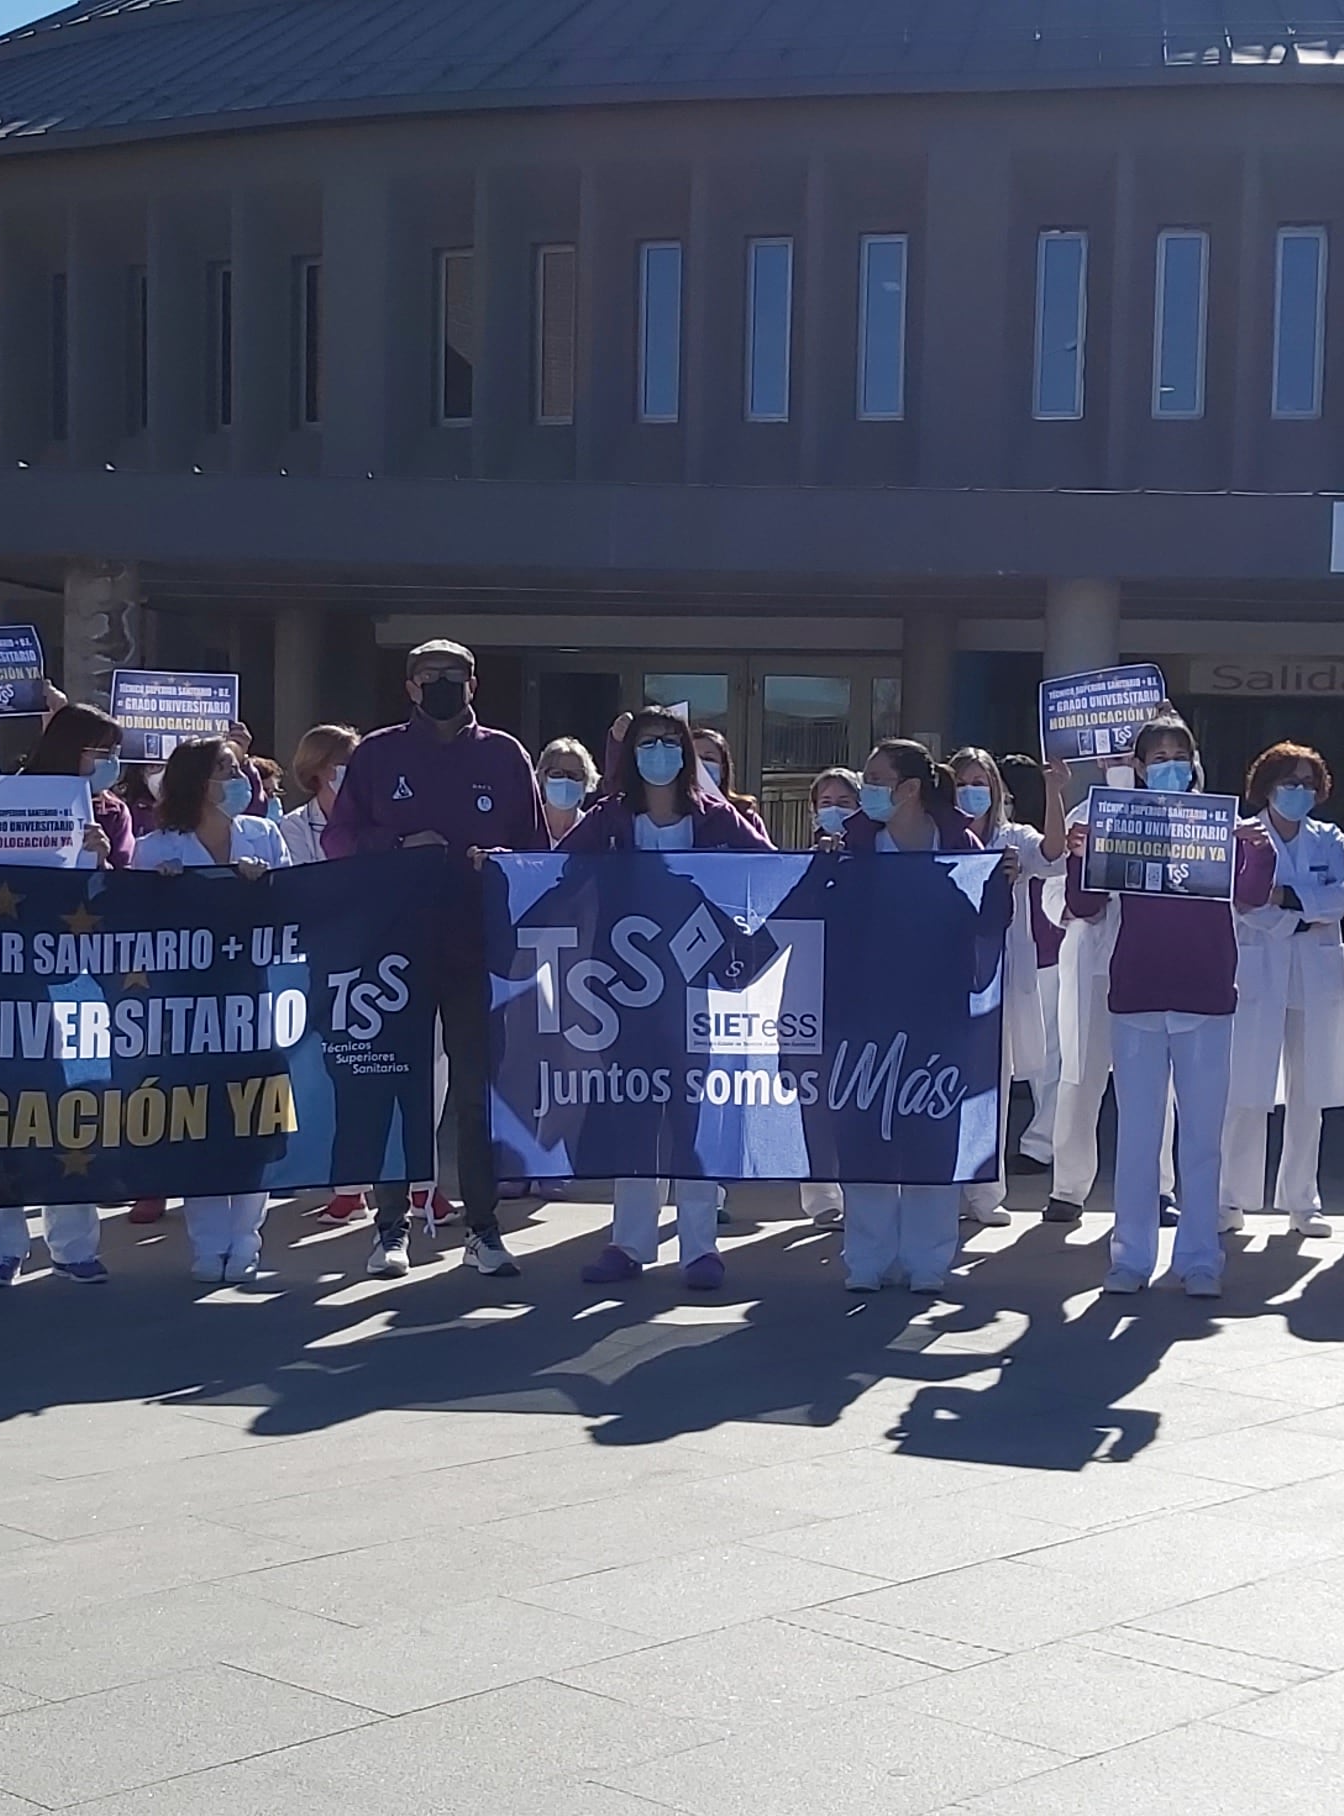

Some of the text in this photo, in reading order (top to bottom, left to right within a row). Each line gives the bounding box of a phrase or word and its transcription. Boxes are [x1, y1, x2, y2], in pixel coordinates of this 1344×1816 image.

[26, 666, 41, 680] YA
[125, 698, 156, 712] GRADO
[158, 699, 230, 714] UNIVERSITARIO
[1057, 698, 1088, 713] GRADO
[1089, 690, 1160, 709] UNIVERSITARIO
[116, 715, 230, 732] HOMOLOGACIÓN YA
[1049, 707, 1145, 730] HOMOLOGACIÓN
[9, 820, 75, 832] UNIVERSITARIO
[1106, 818, 1142, 836] GRADO
[1145, 821, 1228, 842] UNIVERSITARIO
[60, 836, 74, 848] YA
[1095, 837, 1226, 862] HOMOLOGACIÓN YA
[1167, 863, 1190, 884] TSS
[33, 929, 213, 975] SANITARIO
[221, 936, 243, 961] +
[251, 924, 308, 966] U.E.
[516, 915, 665, 1052] TSS
[327, 953, 411, 1040] TSS
[692, 1012, 818, 1038] SIETeSS
[321, 1041, 372, 1053] Técnicos
[336, 1052, 395, 1064] Superiores
[352, 1063, 410, 1074] Sanitarios
[533, 1031, 968, 1141] Juntos somos Más
[227, 1073, 299, 1137] YA
